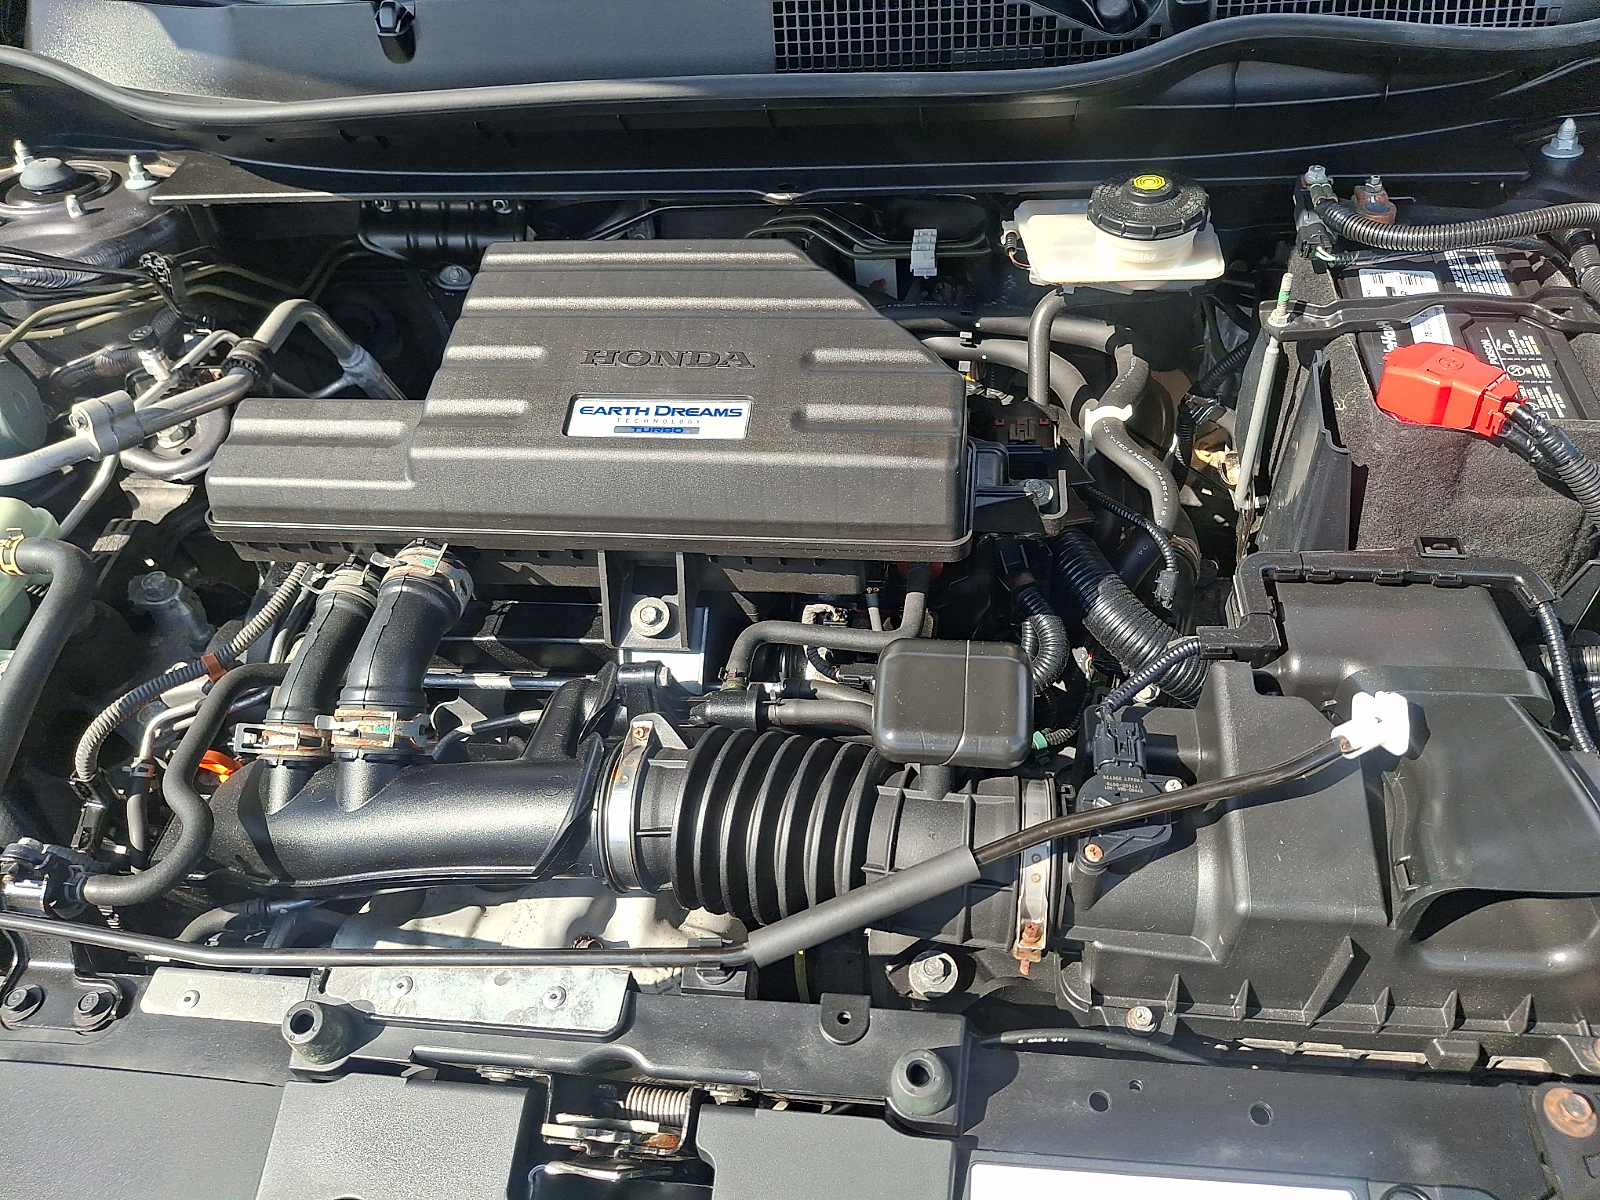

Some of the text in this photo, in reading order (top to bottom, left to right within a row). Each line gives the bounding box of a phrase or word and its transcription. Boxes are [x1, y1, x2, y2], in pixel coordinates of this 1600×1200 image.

[580, 349, 756, 370] HONDA
[1481, 339, 1500, 365] POISON
[579, 405, 743, 418] EARTH DREAMS
